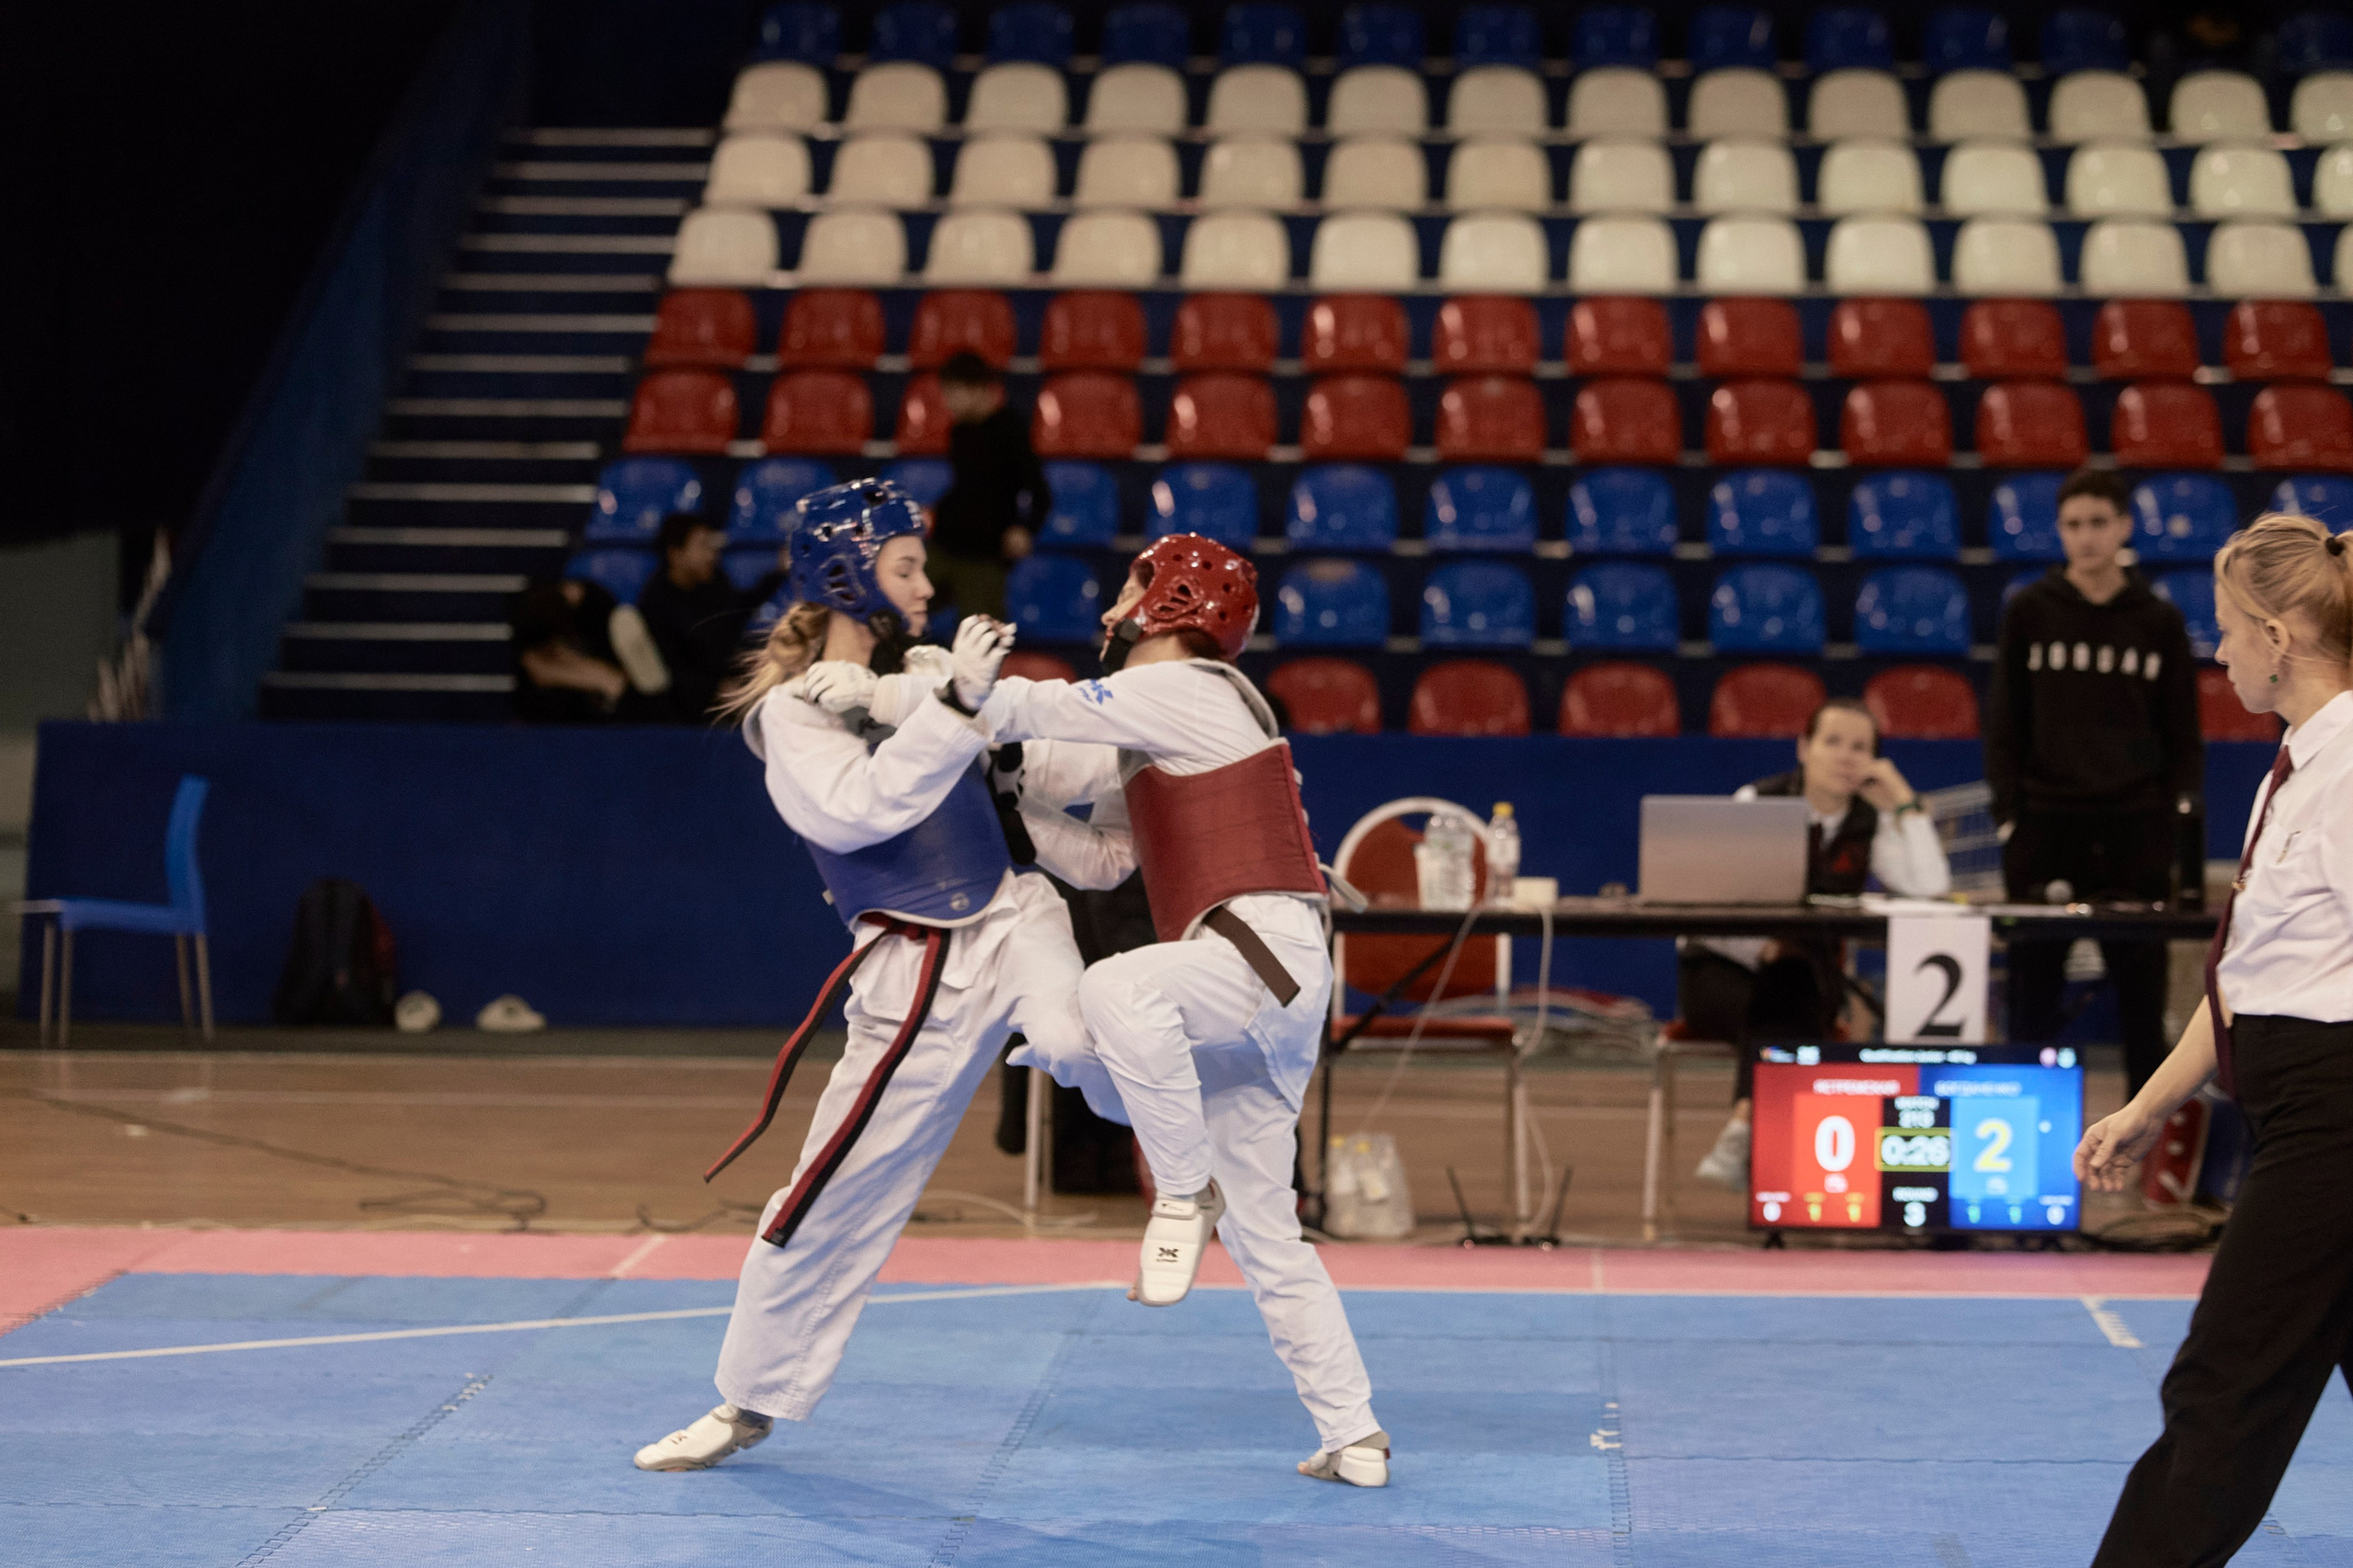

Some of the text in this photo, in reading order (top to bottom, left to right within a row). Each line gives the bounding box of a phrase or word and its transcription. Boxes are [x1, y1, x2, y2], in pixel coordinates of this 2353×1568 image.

[1914, 951, 1964, 1037] 2
[1814, 1115, 1856, 1173] 0
[1881, 1134, 1950, 1166] 0:26
[1972, 1118, 2013, 1173] 2
